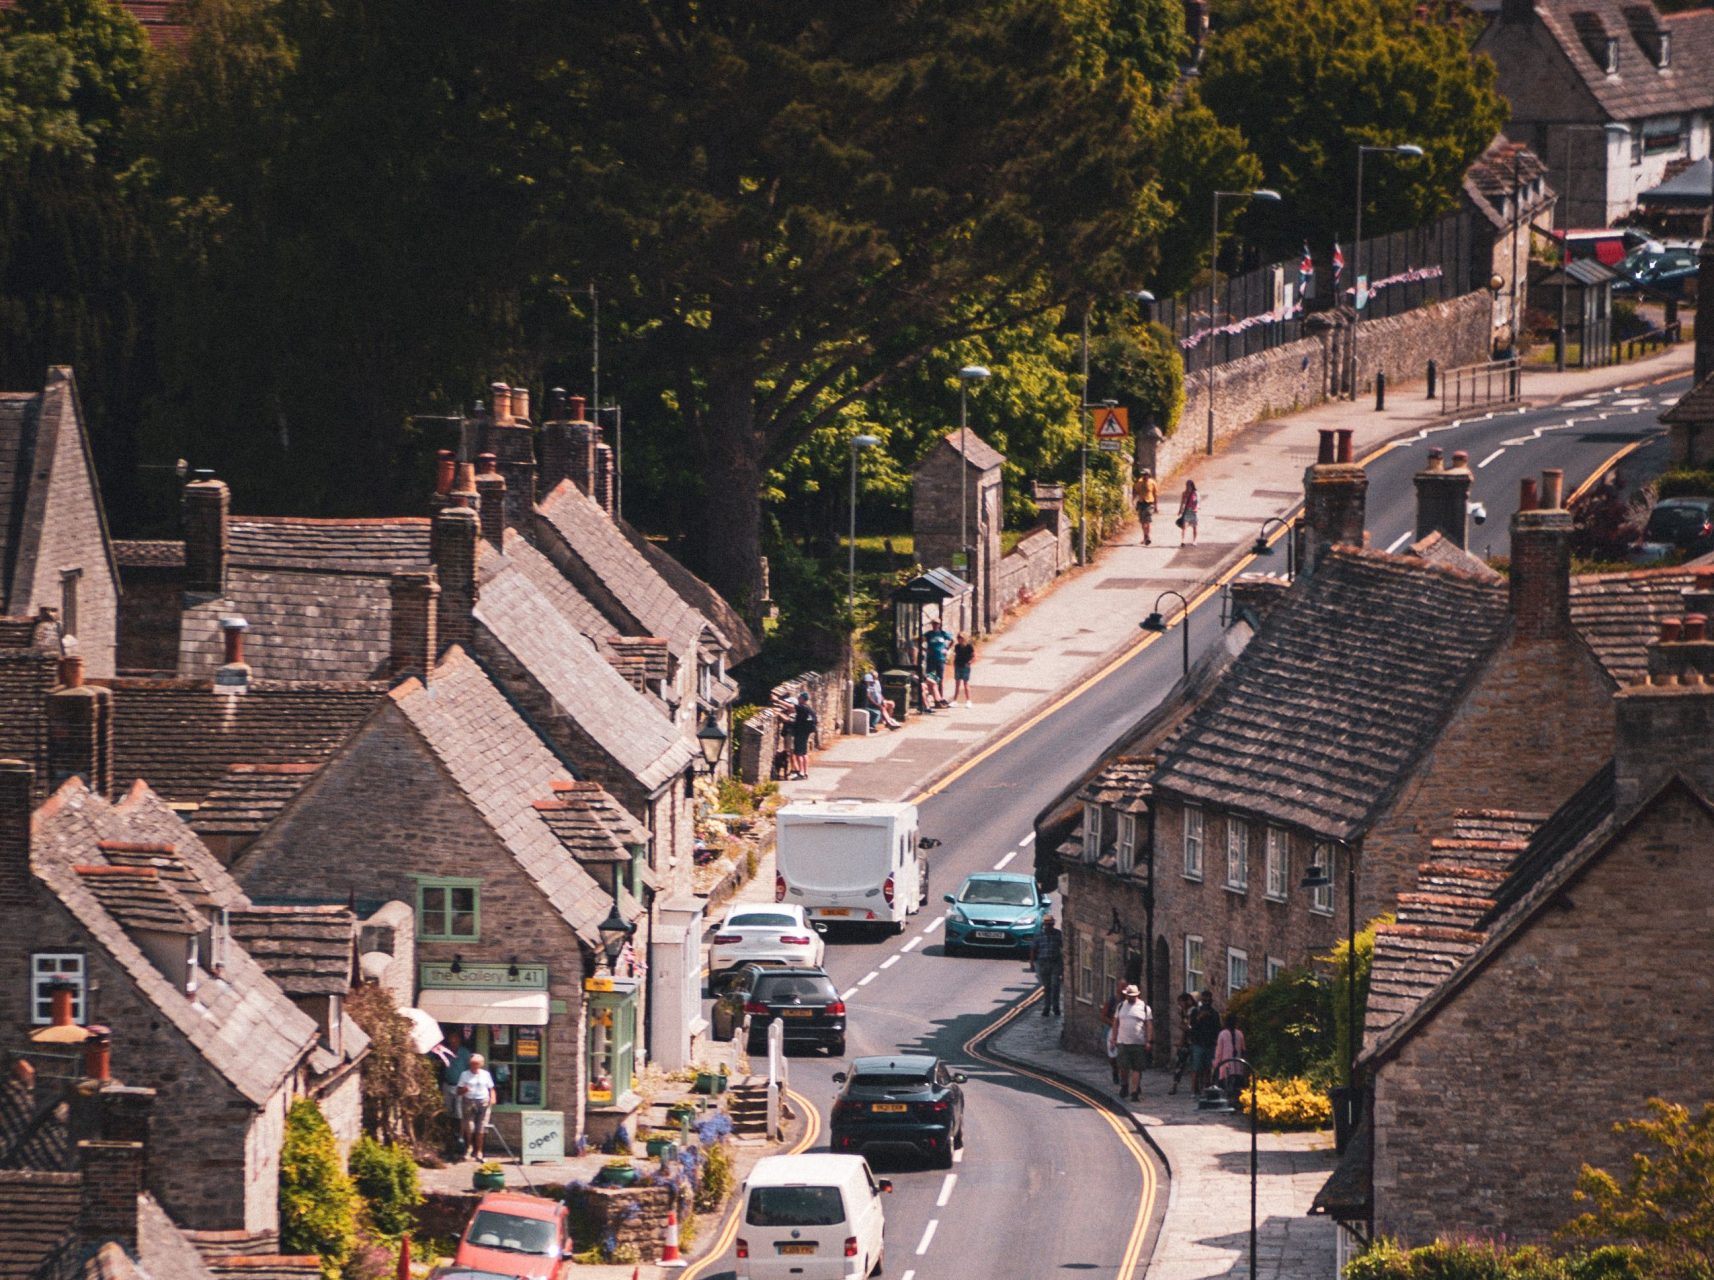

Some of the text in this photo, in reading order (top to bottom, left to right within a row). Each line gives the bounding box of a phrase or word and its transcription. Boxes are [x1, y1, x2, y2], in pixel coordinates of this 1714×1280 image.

[431, 969, 453, 981] the
[458, 969, 504, 984] Gallery
[524, 971, 537, 982] 41
[524, 1116, 562, 1127] Gallery
[528, 1131, 559, 1150] open
